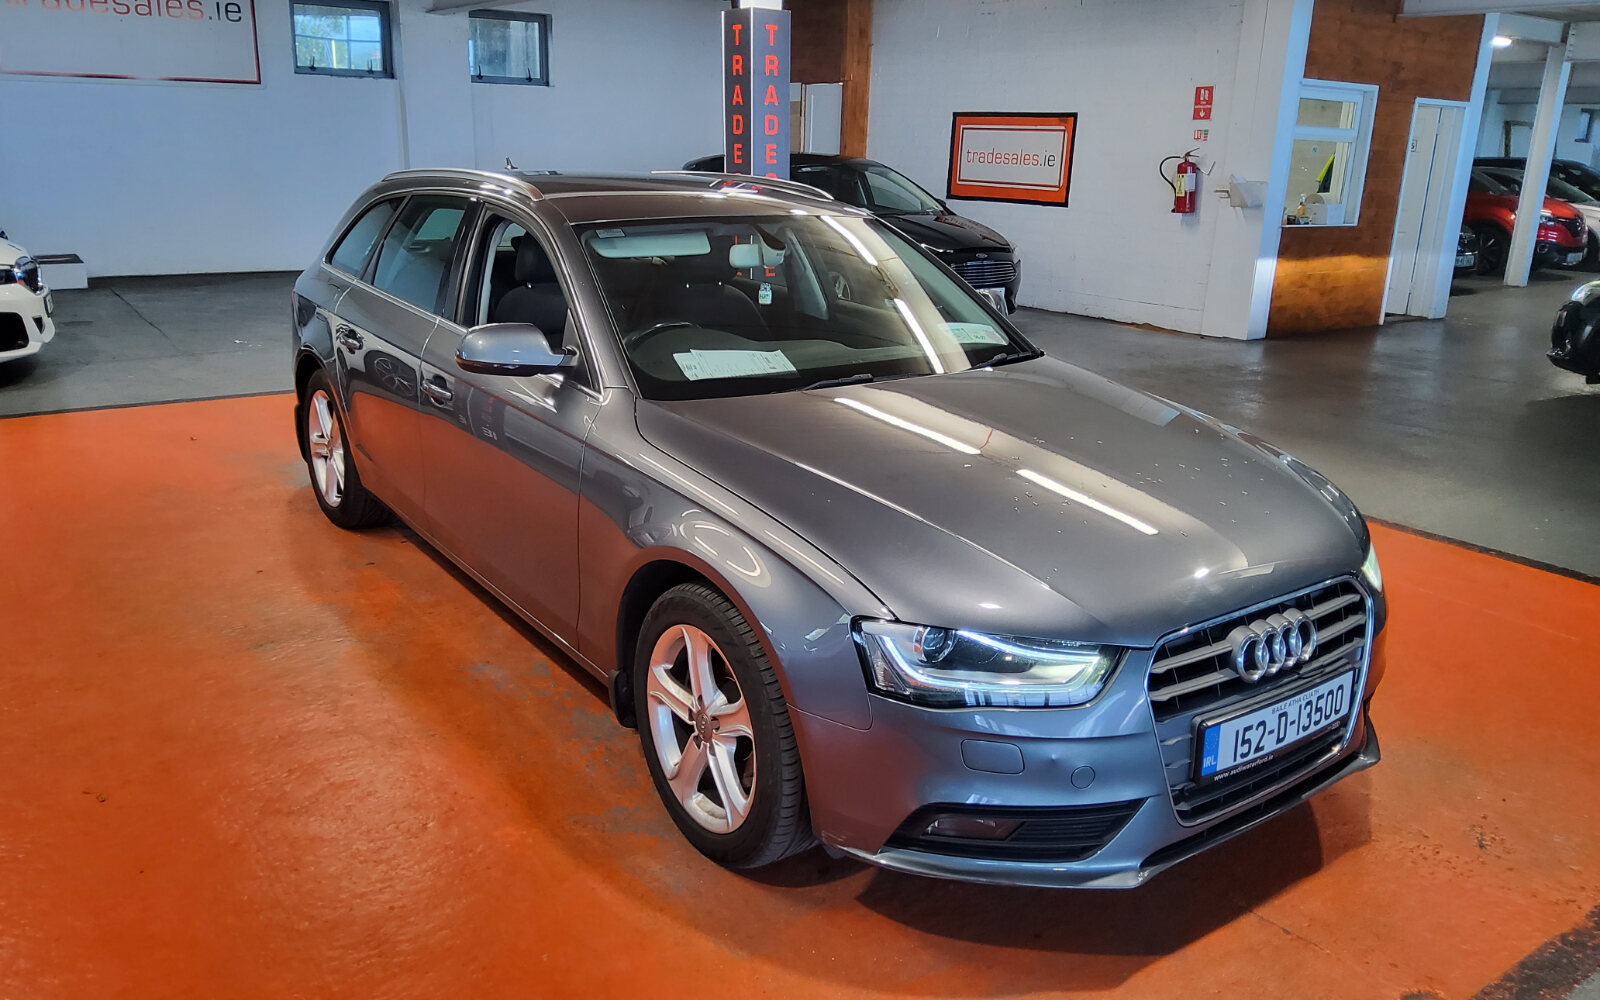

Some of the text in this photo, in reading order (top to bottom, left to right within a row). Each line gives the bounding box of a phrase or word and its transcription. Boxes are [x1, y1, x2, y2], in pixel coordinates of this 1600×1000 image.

[6, 0, 242, 22] esales.ie
[732, 24, 743, 175] TRADE
[764, 24, 779, 179] TRADE
[966, 147, 1056, 167] tradesales.ie
[1233, 684, 1344, 763] 152-D-13500
[1203, 755, 1217, 768] IRL
[1213, 754, 1274, 781] www.audiwaterford.ie
